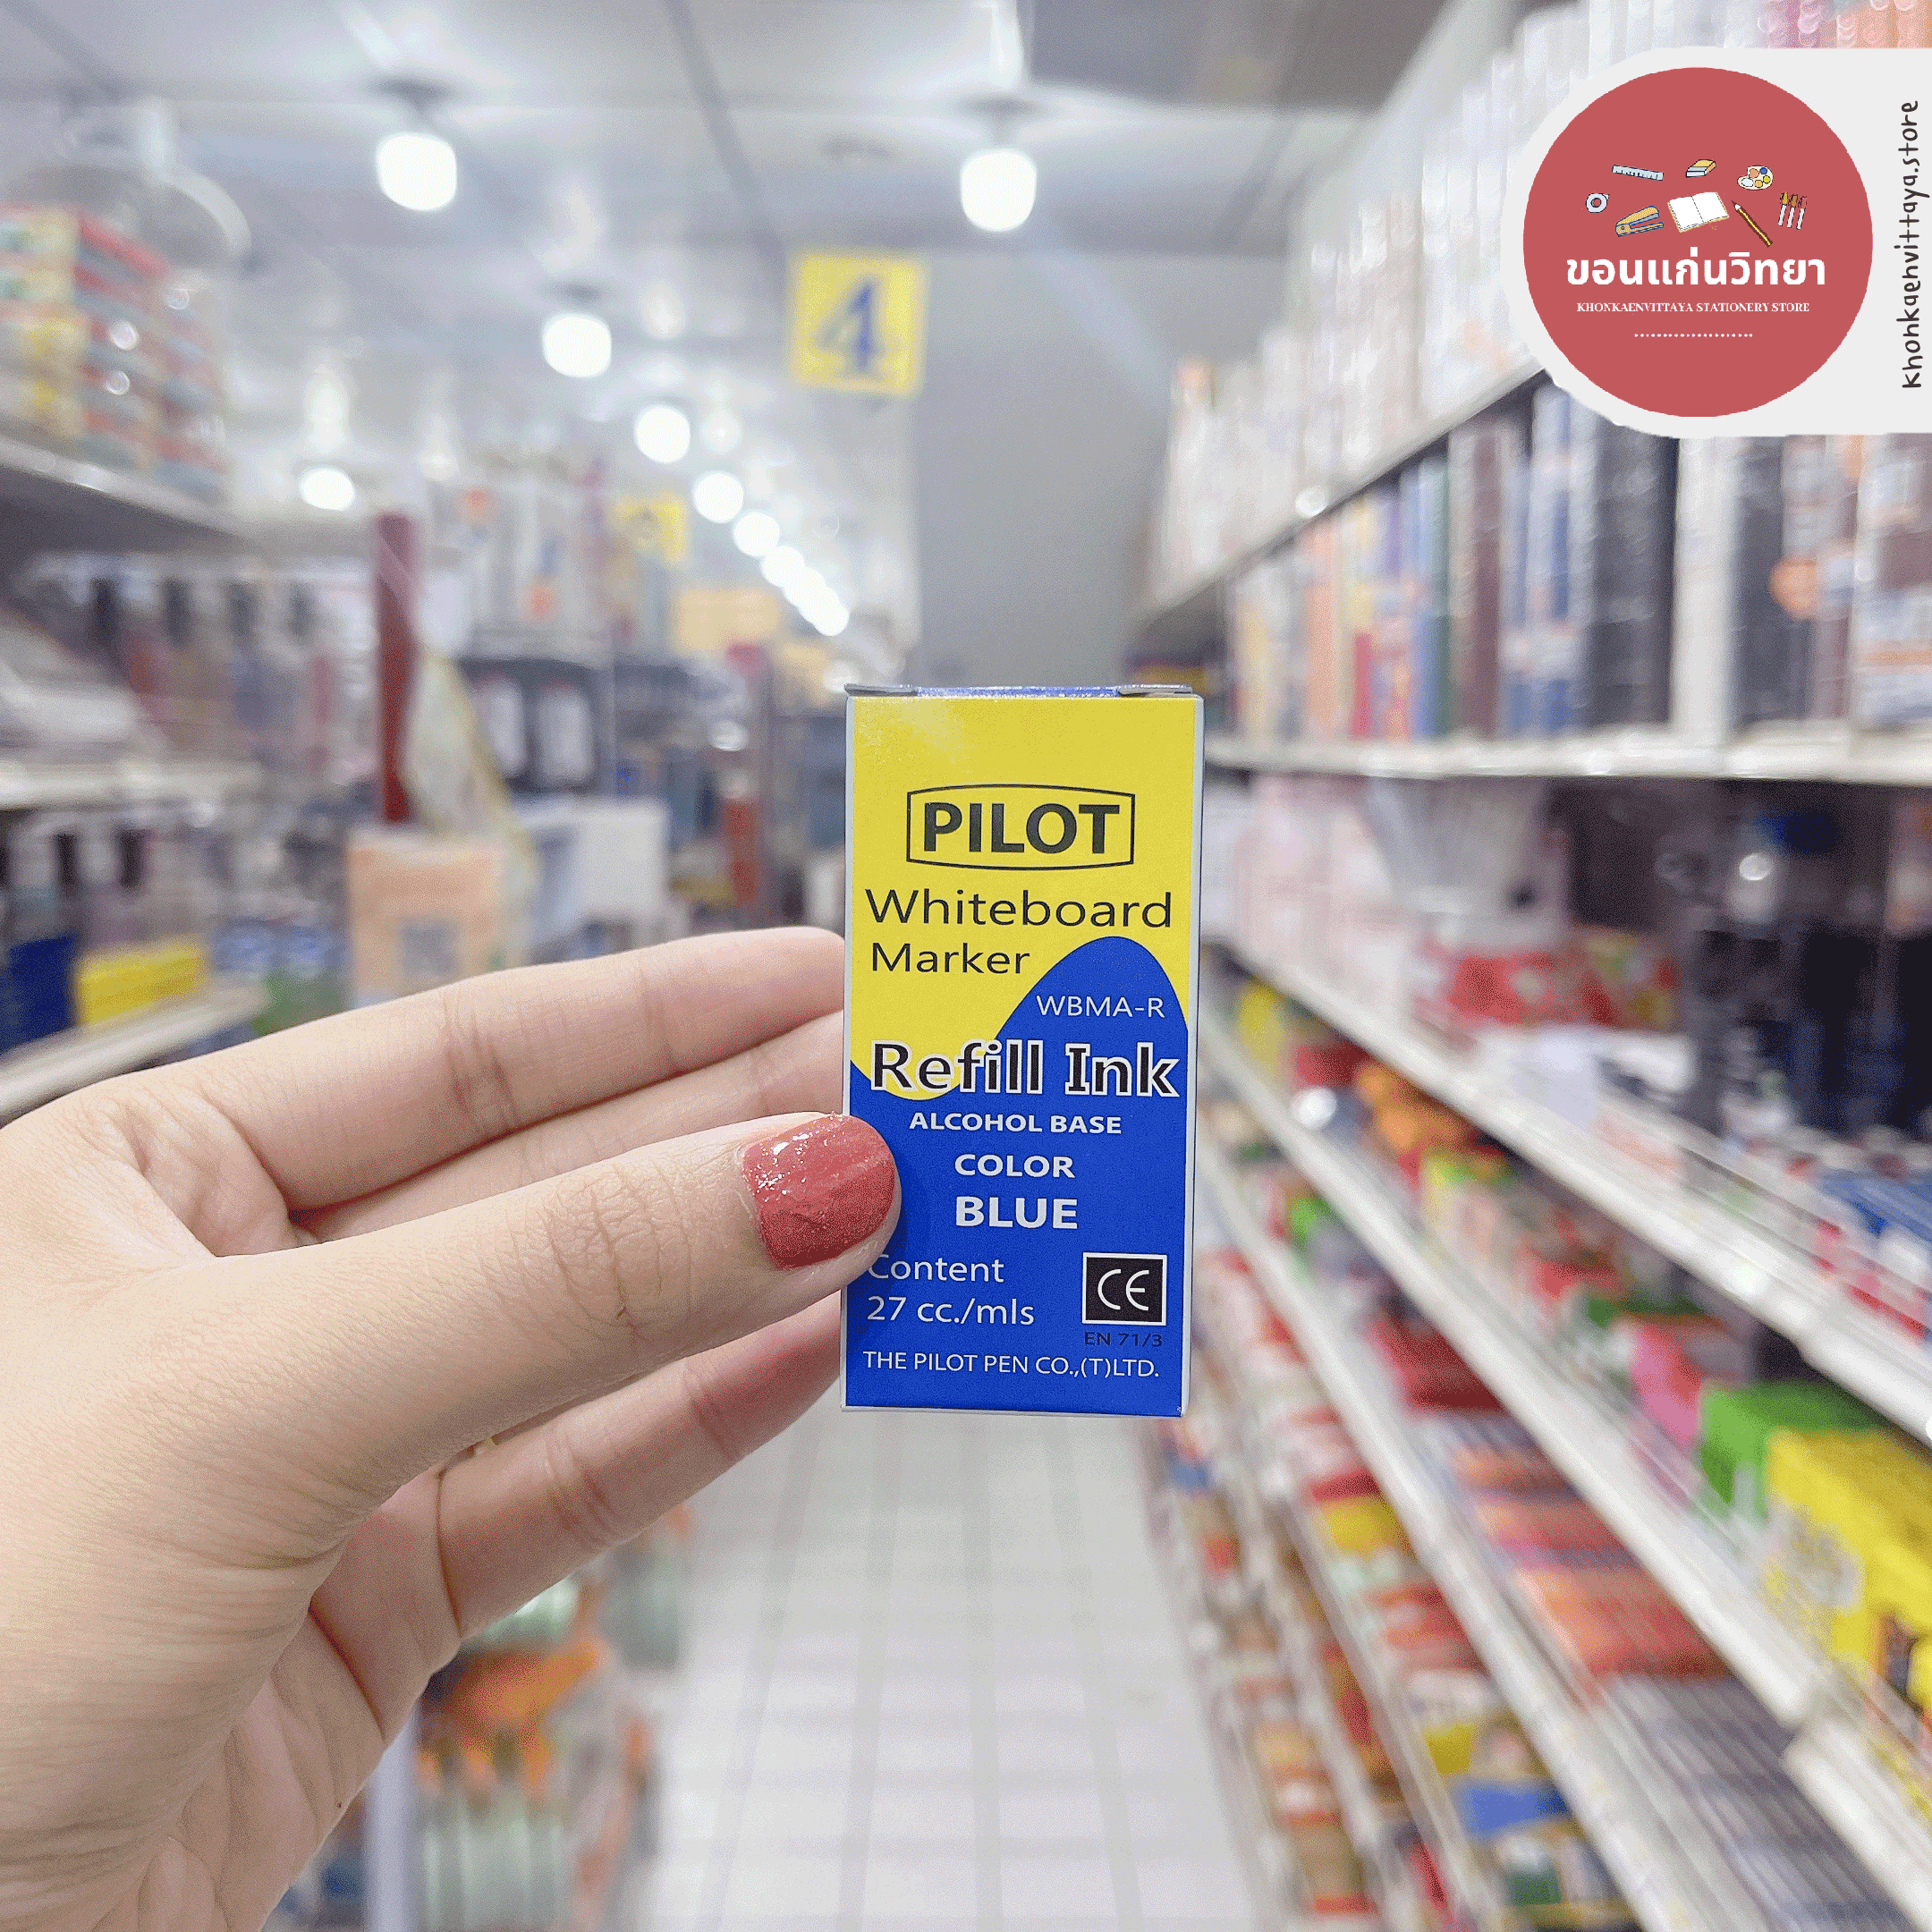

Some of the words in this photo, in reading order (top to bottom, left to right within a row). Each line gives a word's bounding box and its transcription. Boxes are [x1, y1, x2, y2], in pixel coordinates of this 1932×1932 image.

[818, 281, 886, 381] 4
[923, 802, 1120, 854] PILOT
[865, 888, 1172, 928] Whiteboard
[872, 942, 1030, 974] Marker
[1036, 995, 1165, 1018] WBMA-R
[870, 1039, 1044, 1095] Refill
[1064, 1042, 1180, 1097] Ink
[910, 1112, 1043, 1132] ALCOHOL
[1050, 1115, 1122, 1134] BASE
[954, 1154, 1075, 1178] COLOR
[955, 1196, 1078, 1230] BLUE
[868, 1254, 1004, 1284] Content
[1097, 1268, 1149, 1311] CE
[867, 1296, 907, 1321] 27
[917, 1298, 1035, 1326] cc./mls
[1085, 1332, 1111, 1346] EN
[1117, 1333, 1163, 1348] 71/3
[863, 1351, 907, 1369] THE
[913, 1352, 979, 1372] PILOT
[984, 1355, 1028, 1374] PEN
[1035, 1357, 1159, 1378] CO.,(T)LTD.
